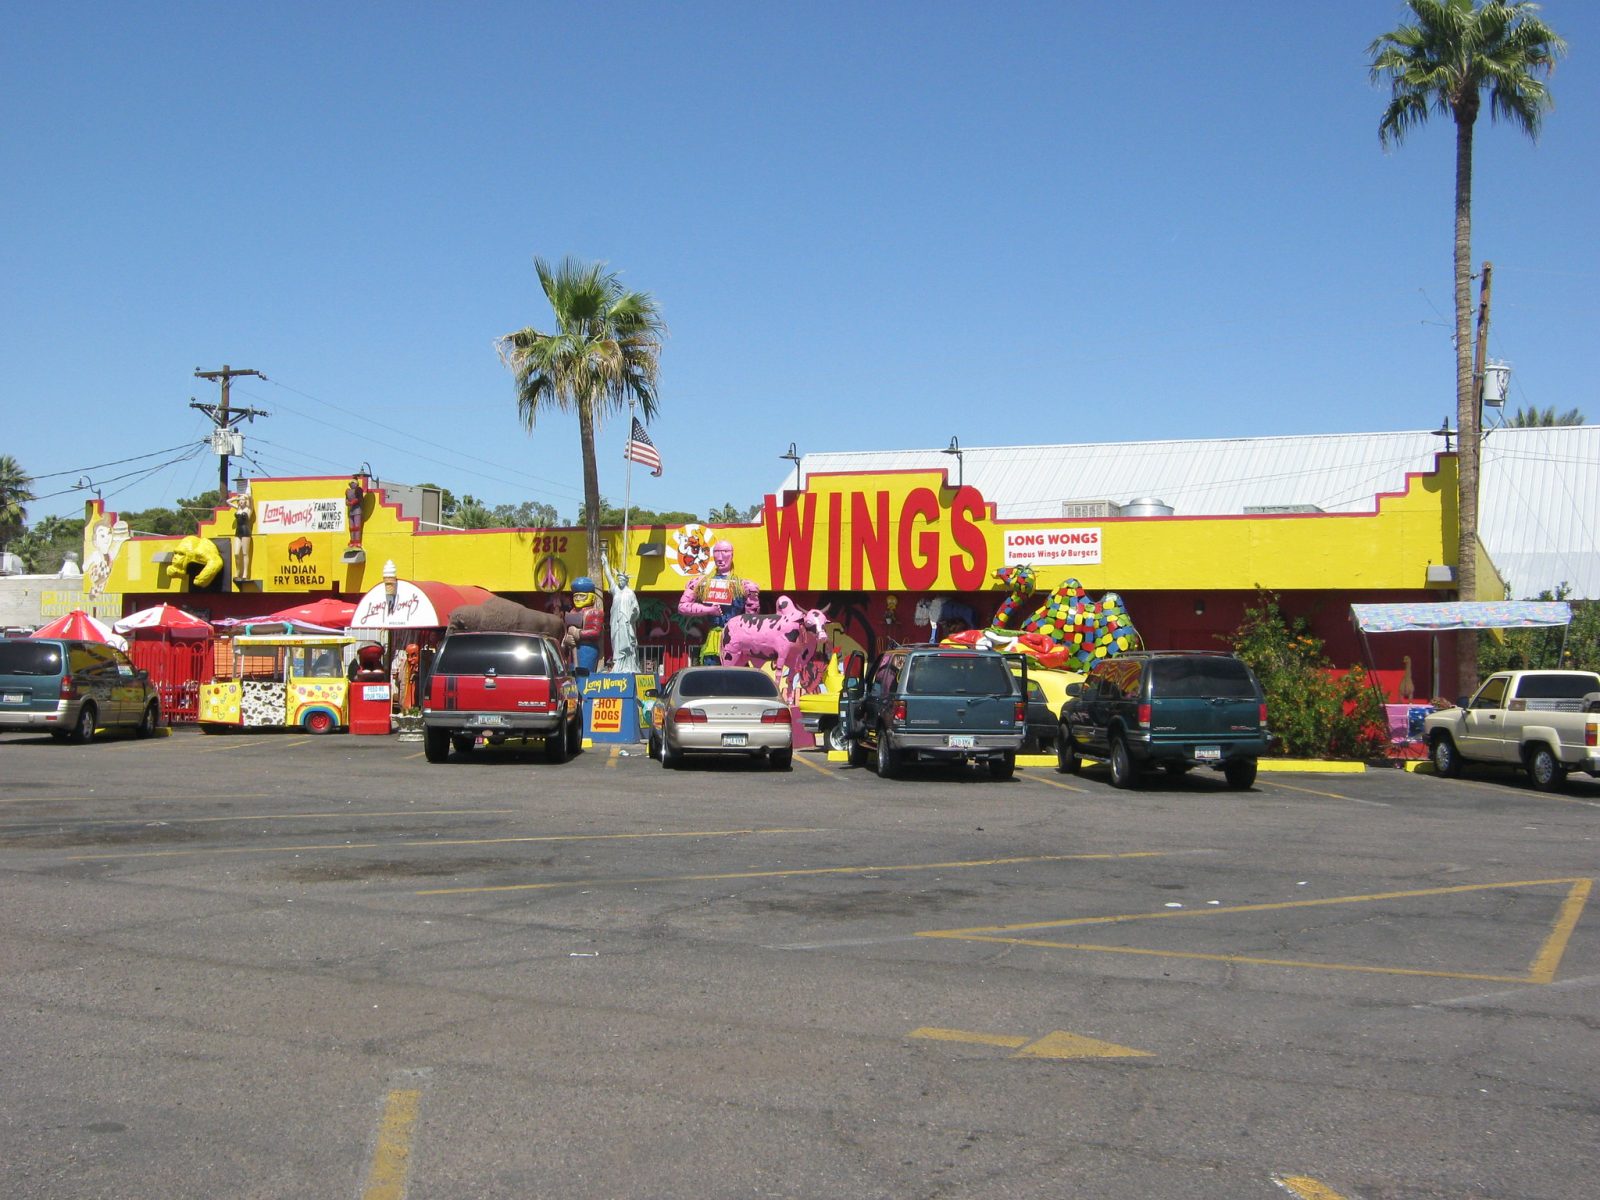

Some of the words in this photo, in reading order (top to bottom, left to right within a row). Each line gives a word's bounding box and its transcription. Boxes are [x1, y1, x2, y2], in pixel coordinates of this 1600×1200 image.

[263, 504, 285, 524] Long
[282, 504, 313, 527] Wong's
[322, 512, 341, 520] WINGS
[764, 486, 988, 591] WINGS
[1008, 535, 1044, 546] LONG
[1048, 533, 1098, 544] WONGS
[533, 536, 568, 553] 2812
[1038, 550, 1059, 559] Wings
[1068, 549, 1098, 558] Burgers
[281, 565, 316, 574] INDIAN
[274, 576, 290, 584] FRY
[294, 576, 325, 584] BREAD
[361, 601, 387, 624] Long
[583, 678, 602, 694] Long
[603, 677, 627, 693] Wong's
[638, 678, 655, 687] INDIAN
[598, 699, 617, 708] HOT
[594, 710, 620, 720] DOGS
